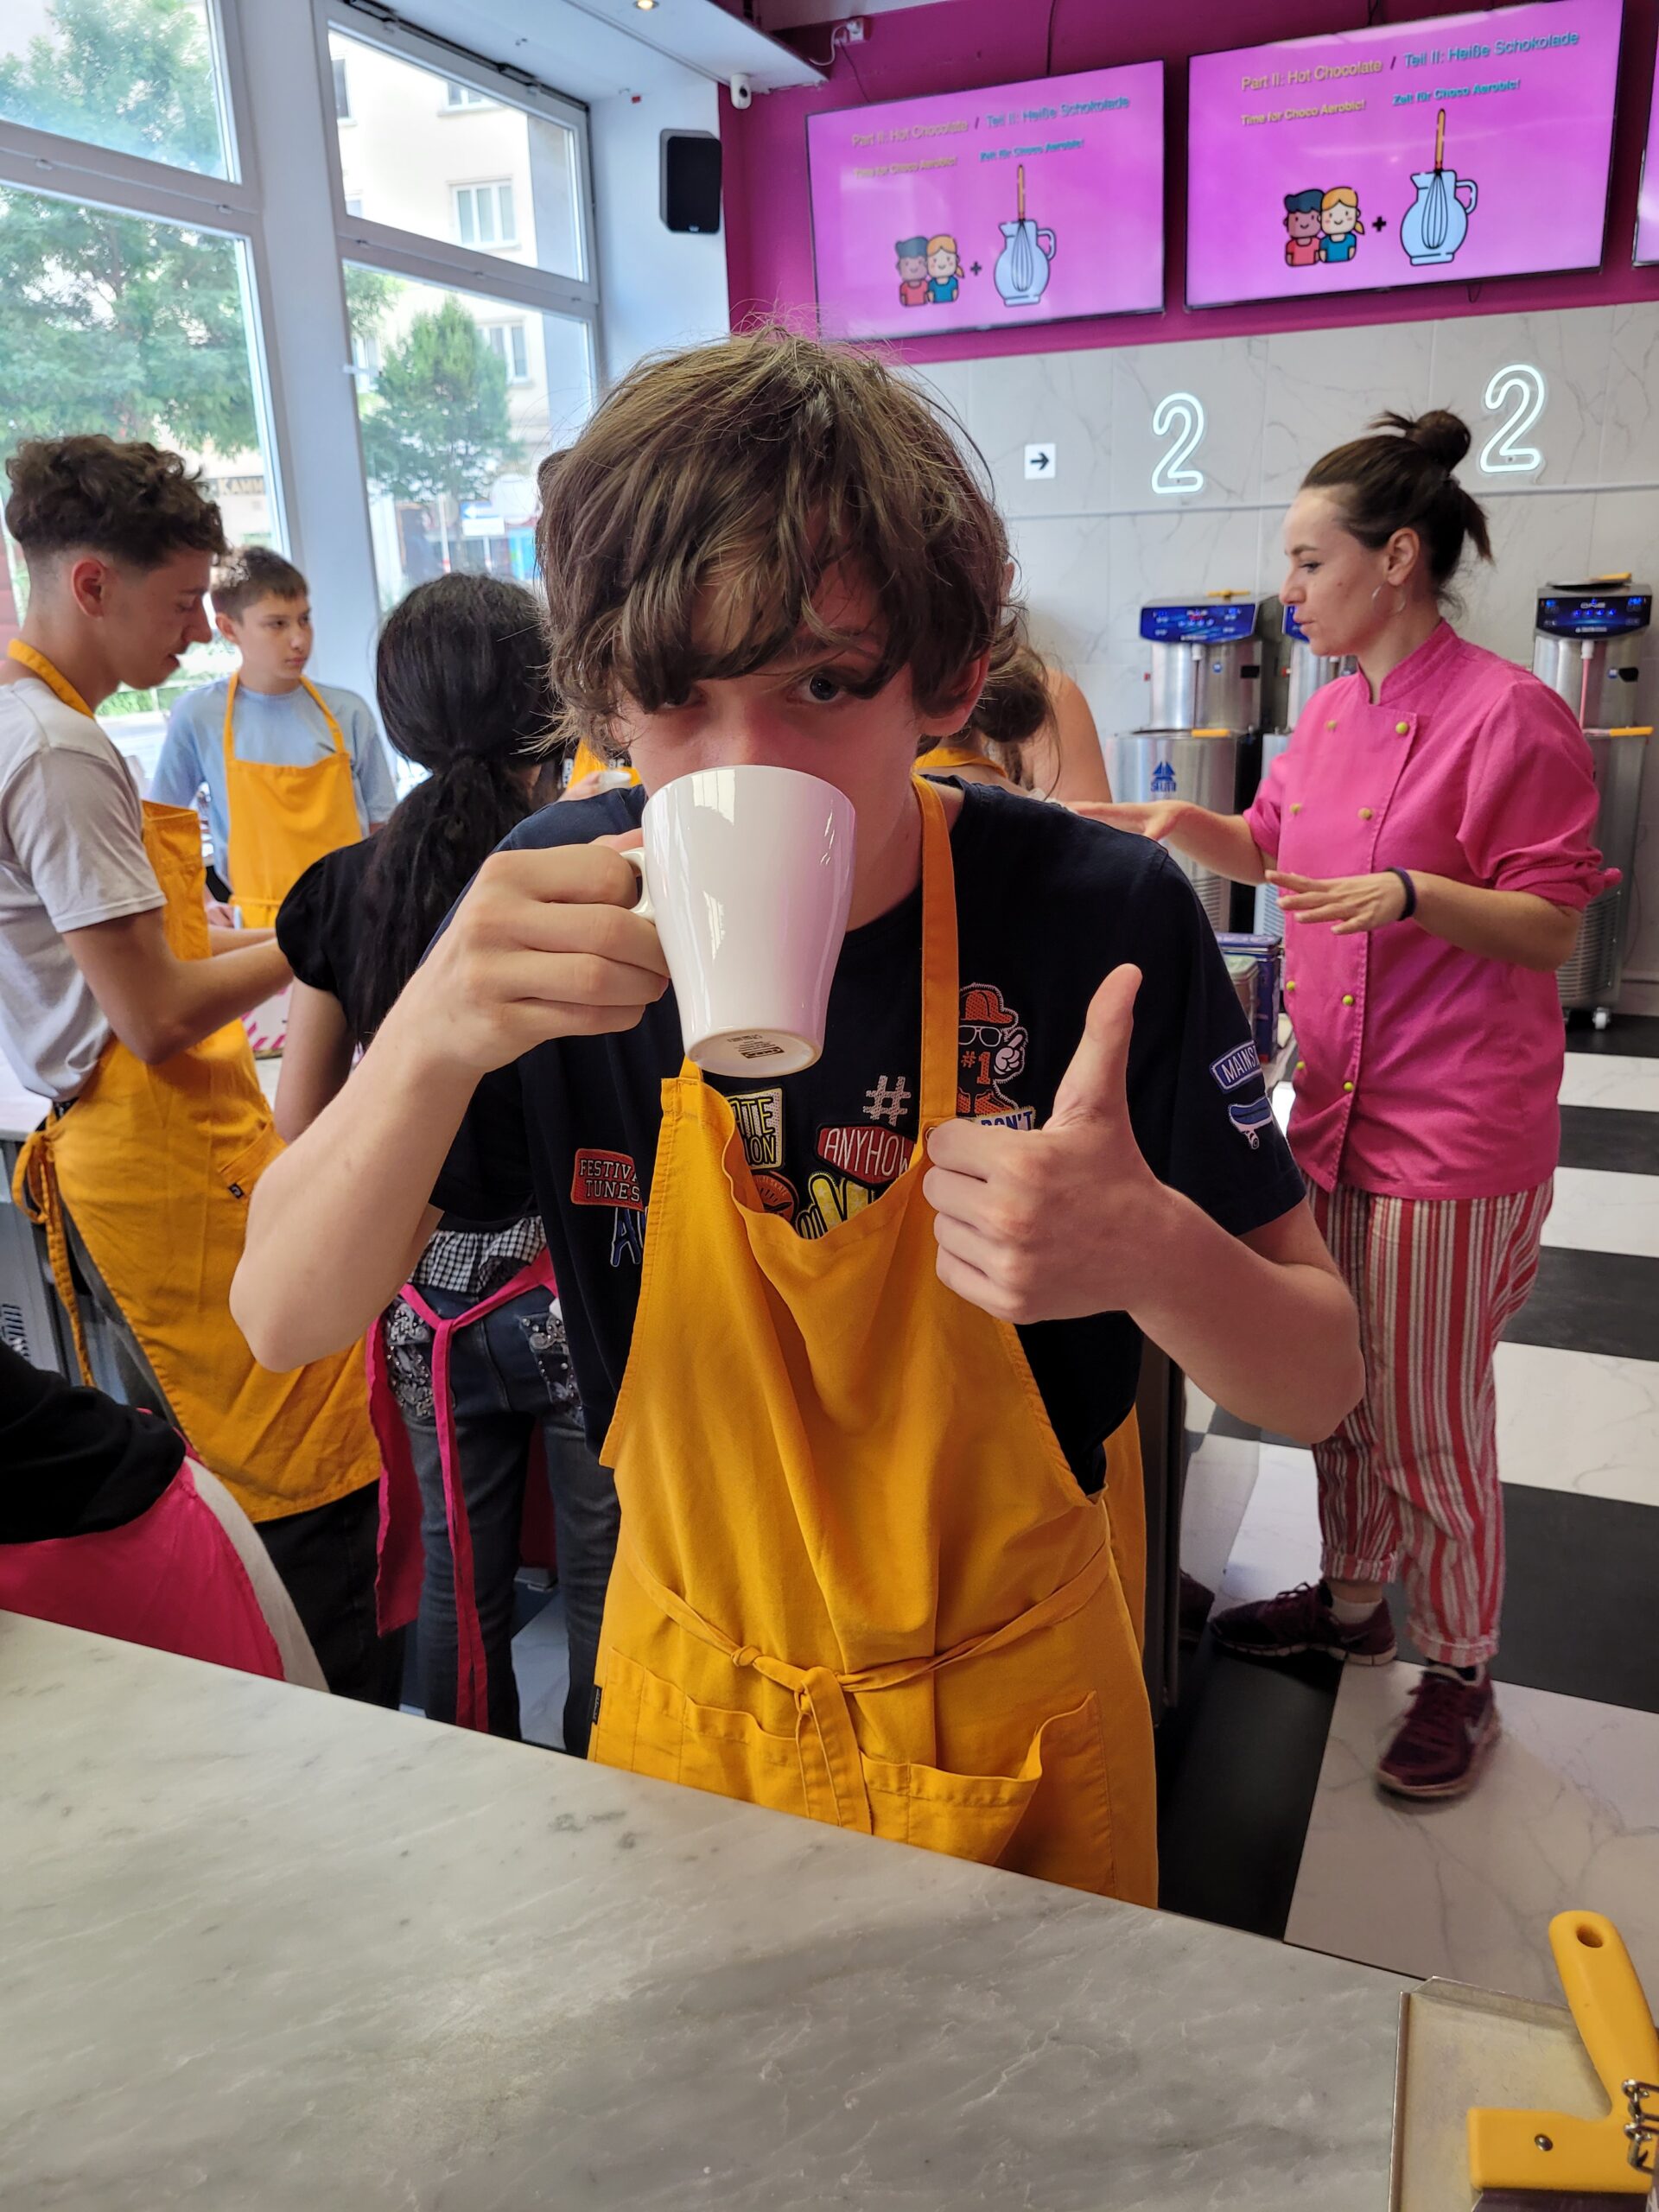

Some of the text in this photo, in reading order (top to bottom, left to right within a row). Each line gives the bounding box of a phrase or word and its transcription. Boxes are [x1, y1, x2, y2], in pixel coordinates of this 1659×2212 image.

[1241, 75, 1269, 91] Part
[1287, 69, 1312, 85] Hot
[1313, 60, 1383, 81] Chocolate
[1403, 52, 1427, 68] Teil
[1447, 44, 1491, 63] Heiße
[1493, 30, 1580, 56] Schokolade
[1392, 79, 1522, 107] Zeit für Choco Aerobic!
[1241, 99, 1367, 126] Time for Choco Aerobic!
[1478, 364, 1546, 473] 2
[1151, 391, 1205, 494] 2
[960, 1050, 991, 1084] #1
[586, 1179, 640, 1202] TUNES
